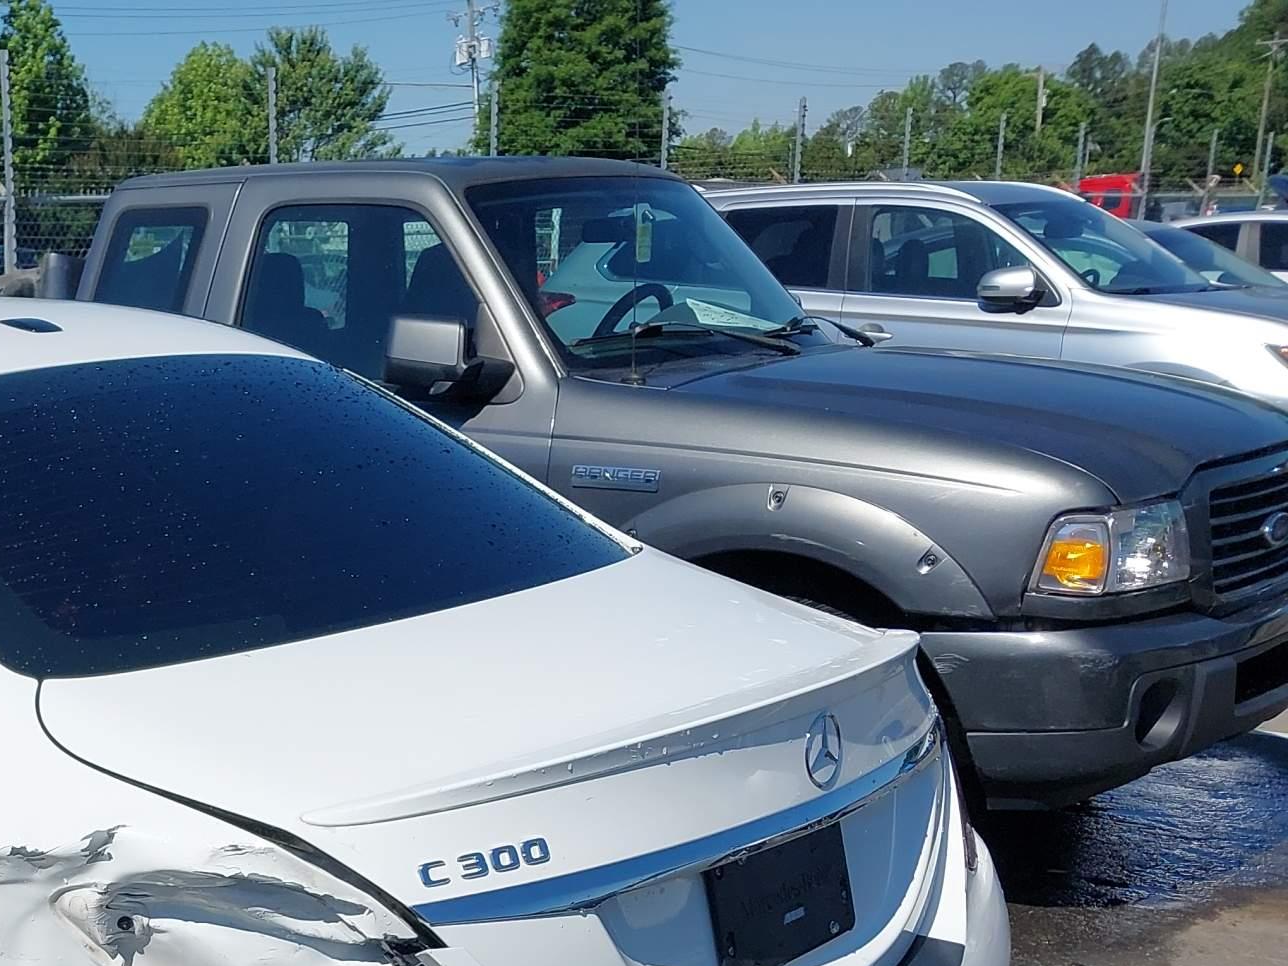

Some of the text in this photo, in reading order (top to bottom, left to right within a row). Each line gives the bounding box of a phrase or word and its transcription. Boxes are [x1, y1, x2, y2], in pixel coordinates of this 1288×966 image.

[572, 464, 660, 483] RANGER
[417, 837, 551, 888] C 300
